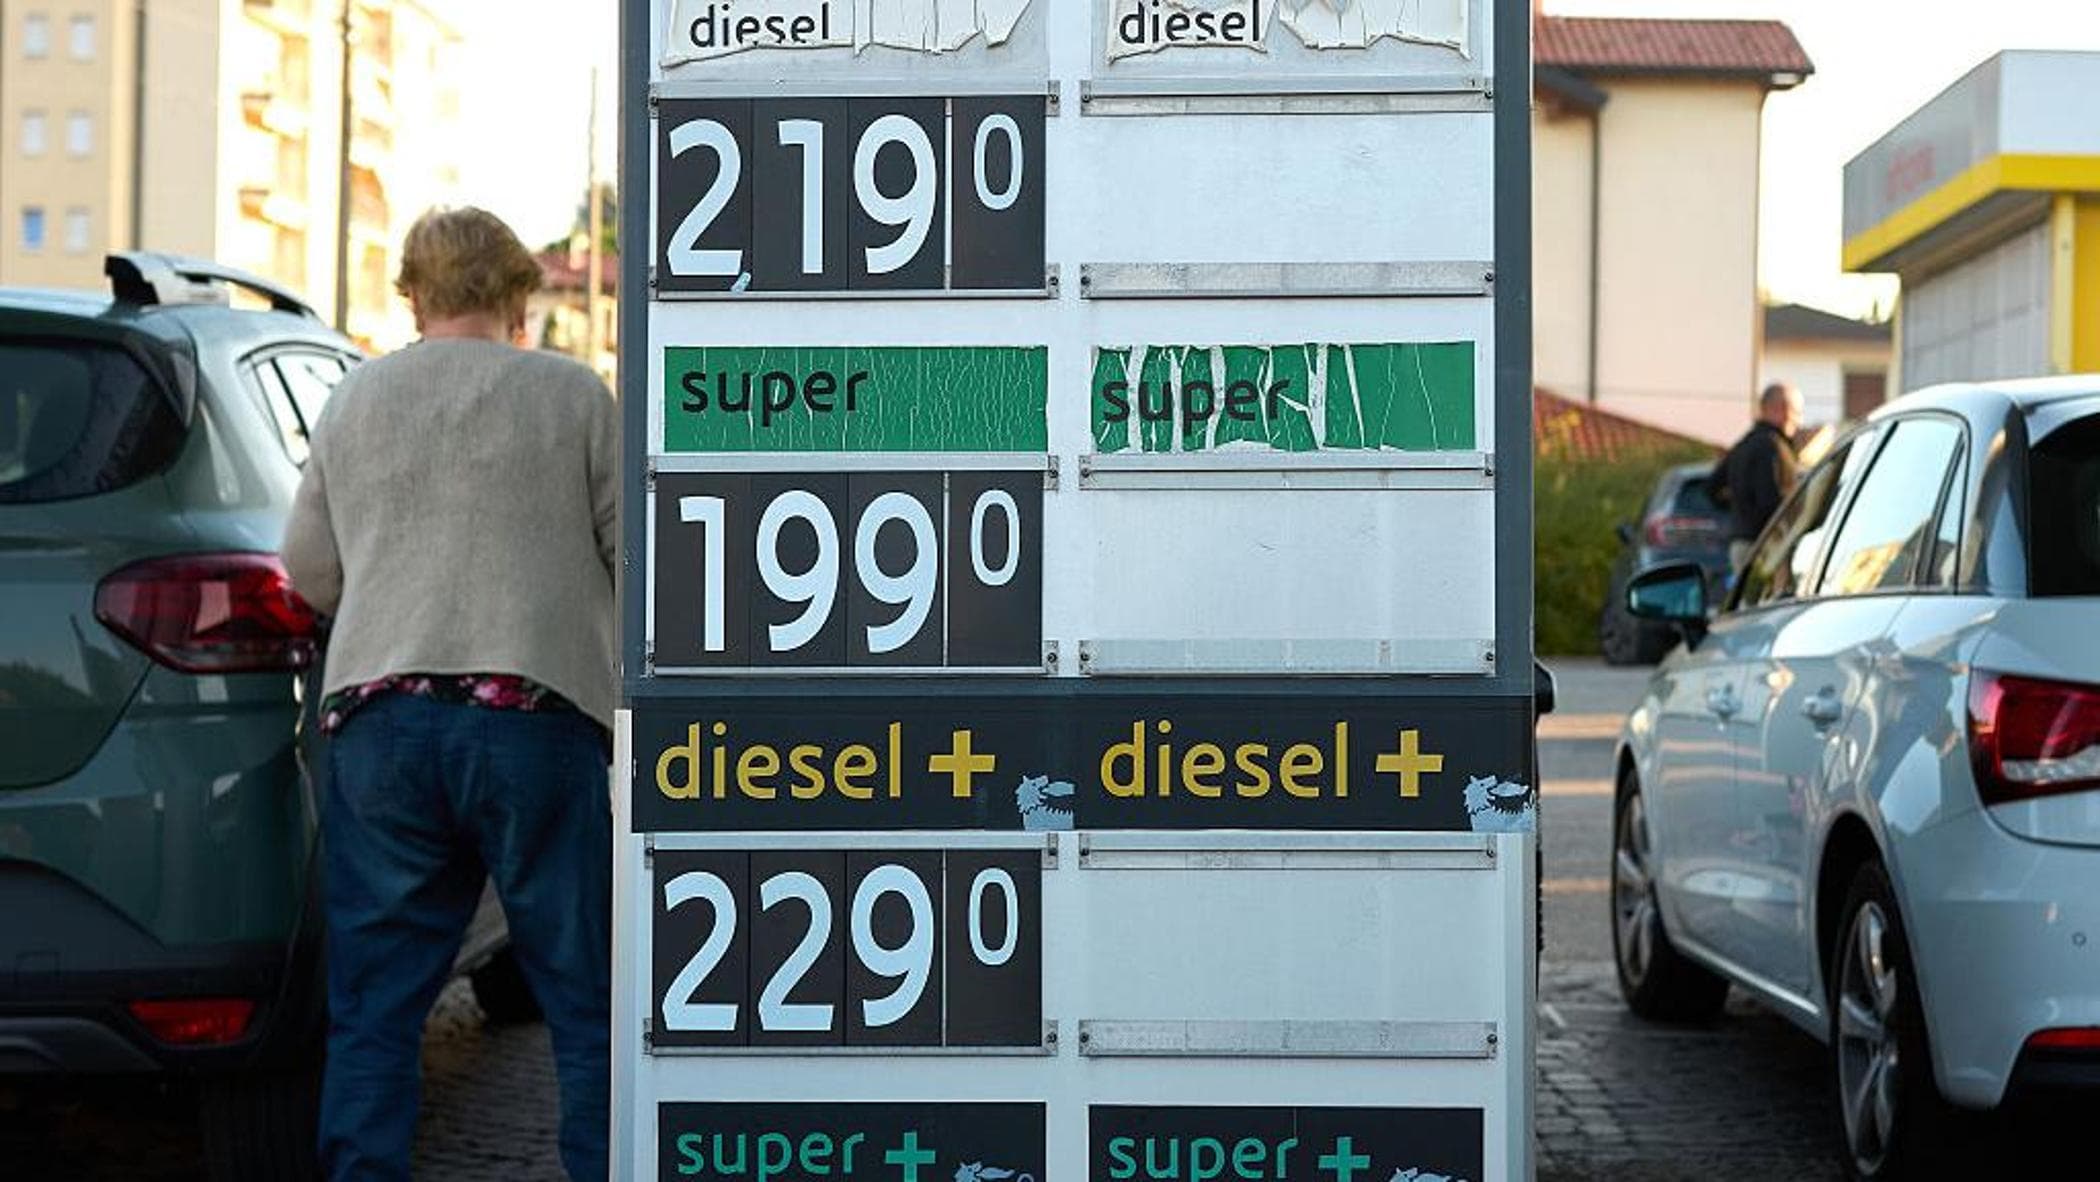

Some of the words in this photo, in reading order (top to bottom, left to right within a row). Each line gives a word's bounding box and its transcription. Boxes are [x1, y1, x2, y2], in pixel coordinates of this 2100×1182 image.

[690, 2, 829, 48] diesel
[1119, 0, 1260, 44] diesel
[682, 370, 868, 427] super
[1102, 379, 1289, 436] super
[656, 722, 901, 799] diesel
[1101, 719, 1348, 798] diesel
[676, 1132, 865, 1182] super
[1108, 1136, 1298, 1182] super
